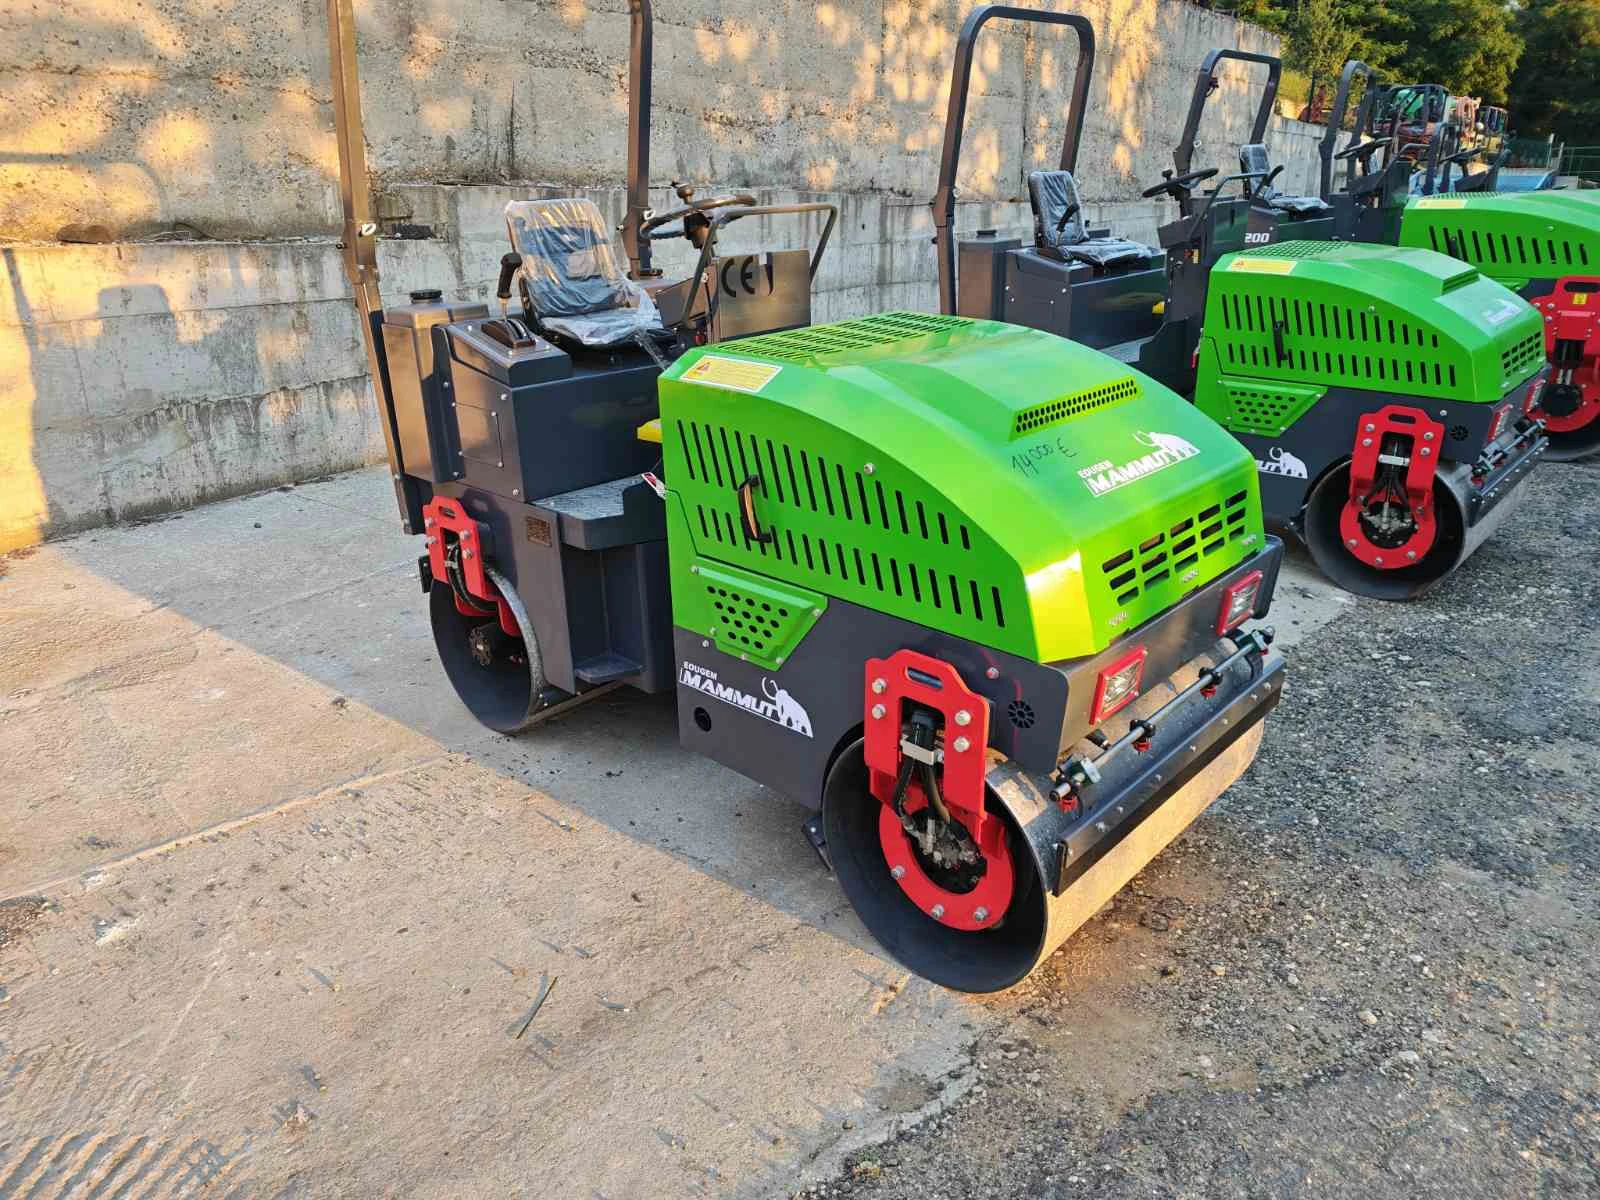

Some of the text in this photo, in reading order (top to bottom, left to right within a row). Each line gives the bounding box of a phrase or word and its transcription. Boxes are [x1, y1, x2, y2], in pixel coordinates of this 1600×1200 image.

[1245, 232, 1270, 244] 200
[721, 255, 756, 298] CE
[1087, 448, 1182, 495] MAMMUT
[683, 669, 779, 718] MAMMUT
